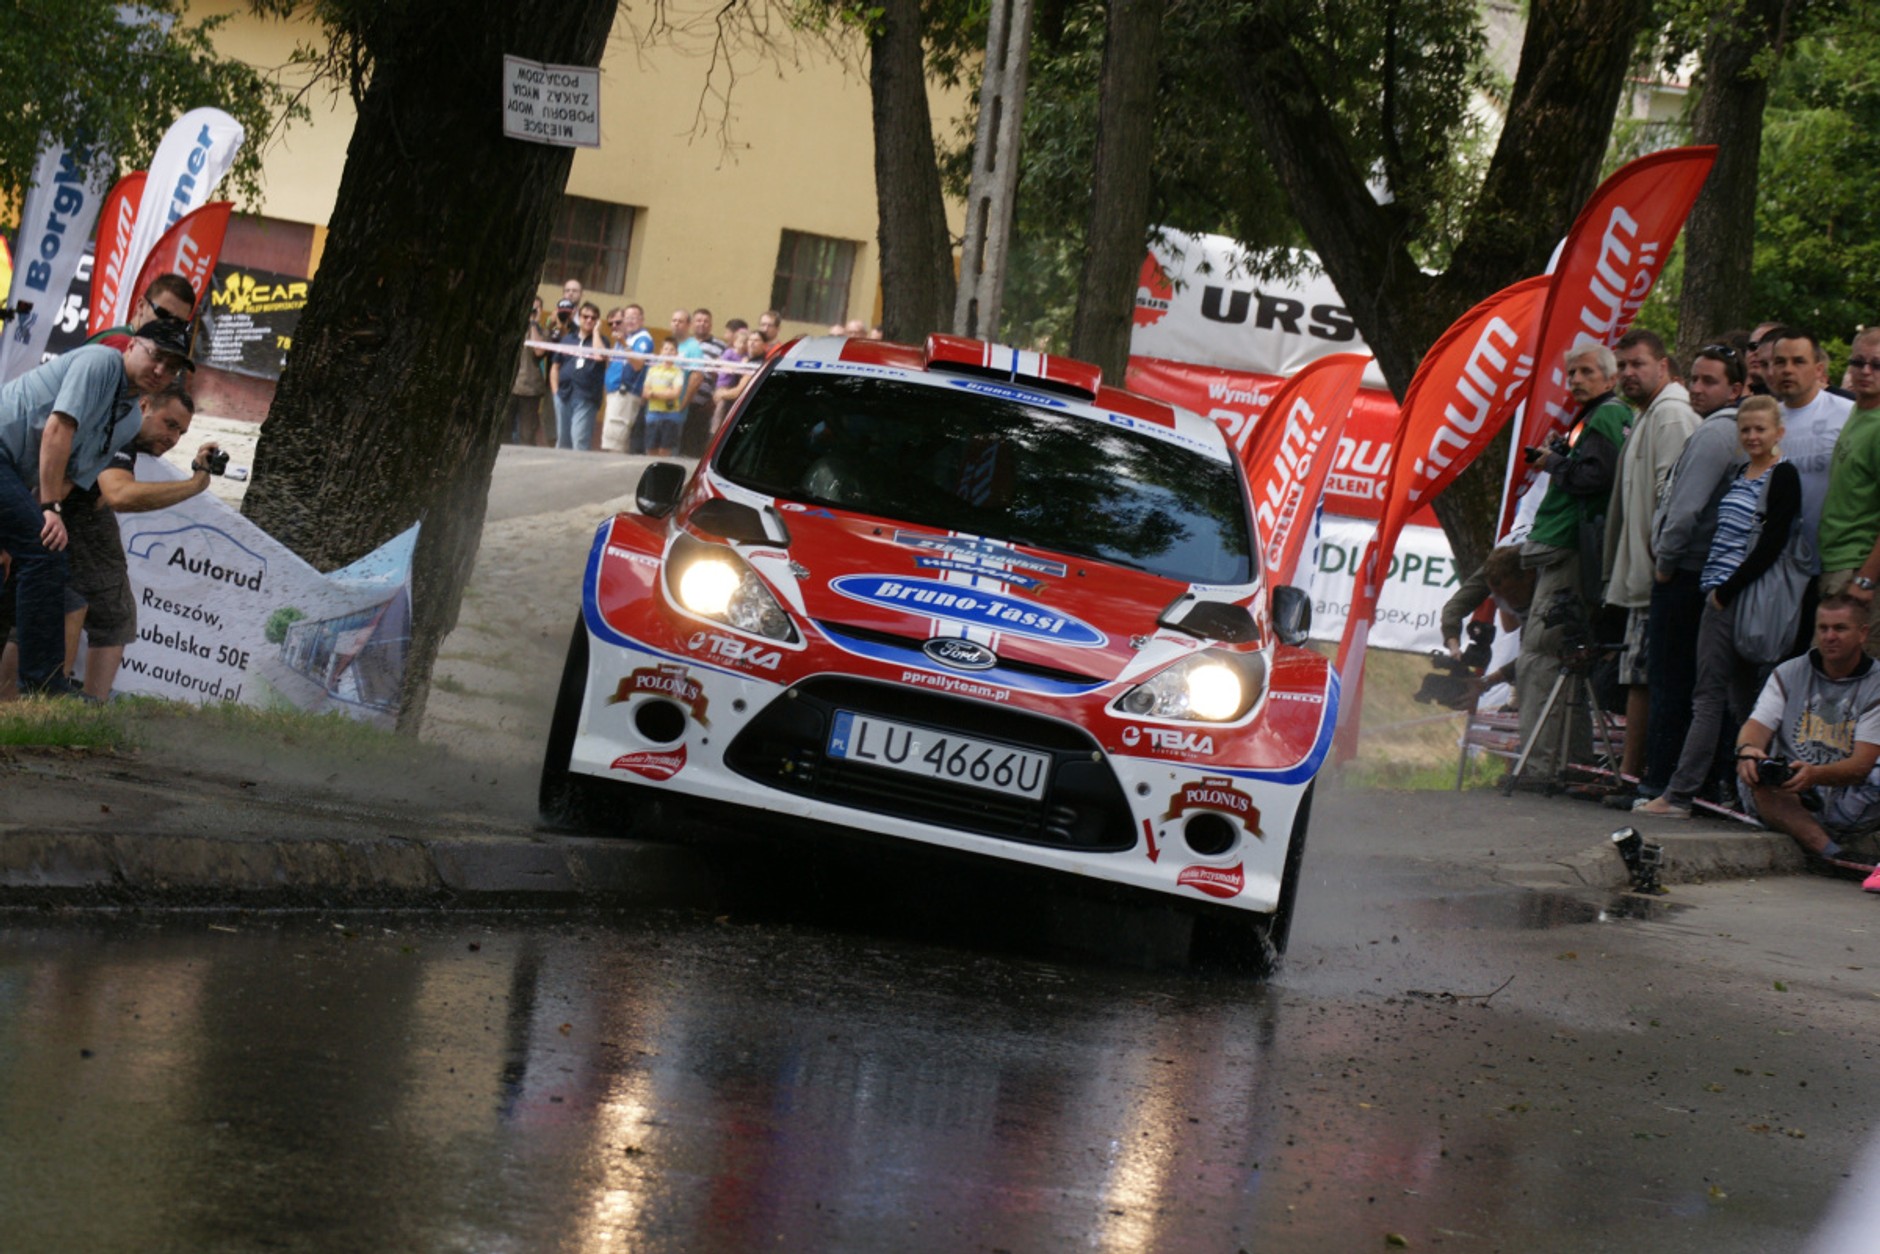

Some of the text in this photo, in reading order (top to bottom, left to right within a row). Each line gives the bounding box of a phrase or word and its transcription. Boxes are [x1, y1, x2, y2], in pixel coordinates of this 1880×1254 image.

[512, 83, 589, 106] ZAKAZ MYCIA
[508, 98, 595, 123] POBORU WODY
[523, 118, 573, 137] MIEJSCE
[165, 124, 213, 231] rner
[1208, 383, 1275, 406] Wymie
[1266, 426, 1327, 565] ORLEN OIL
[1325, 476, 1369, 494] RLEN
[167, 547, 262, 592] Autorud
[142, 587, 224, 631] Rzeszów,
[874, 581, 1067, 634] Bruno-Tassi
[217, 646, 249, 671] 50E
[709, 635, 783, 670] TEKA
[939, 642, 980, 664] Ford
[636, 675, 700, 700] POLONUS
[901, 669, 1010, 701] pprallyteam.pl
[1143, 727, 1214, 756] TEKA
[832, 721, 1043, 792] PL LU 4666U
[1186, 790, 1249, 812] POLONUS
